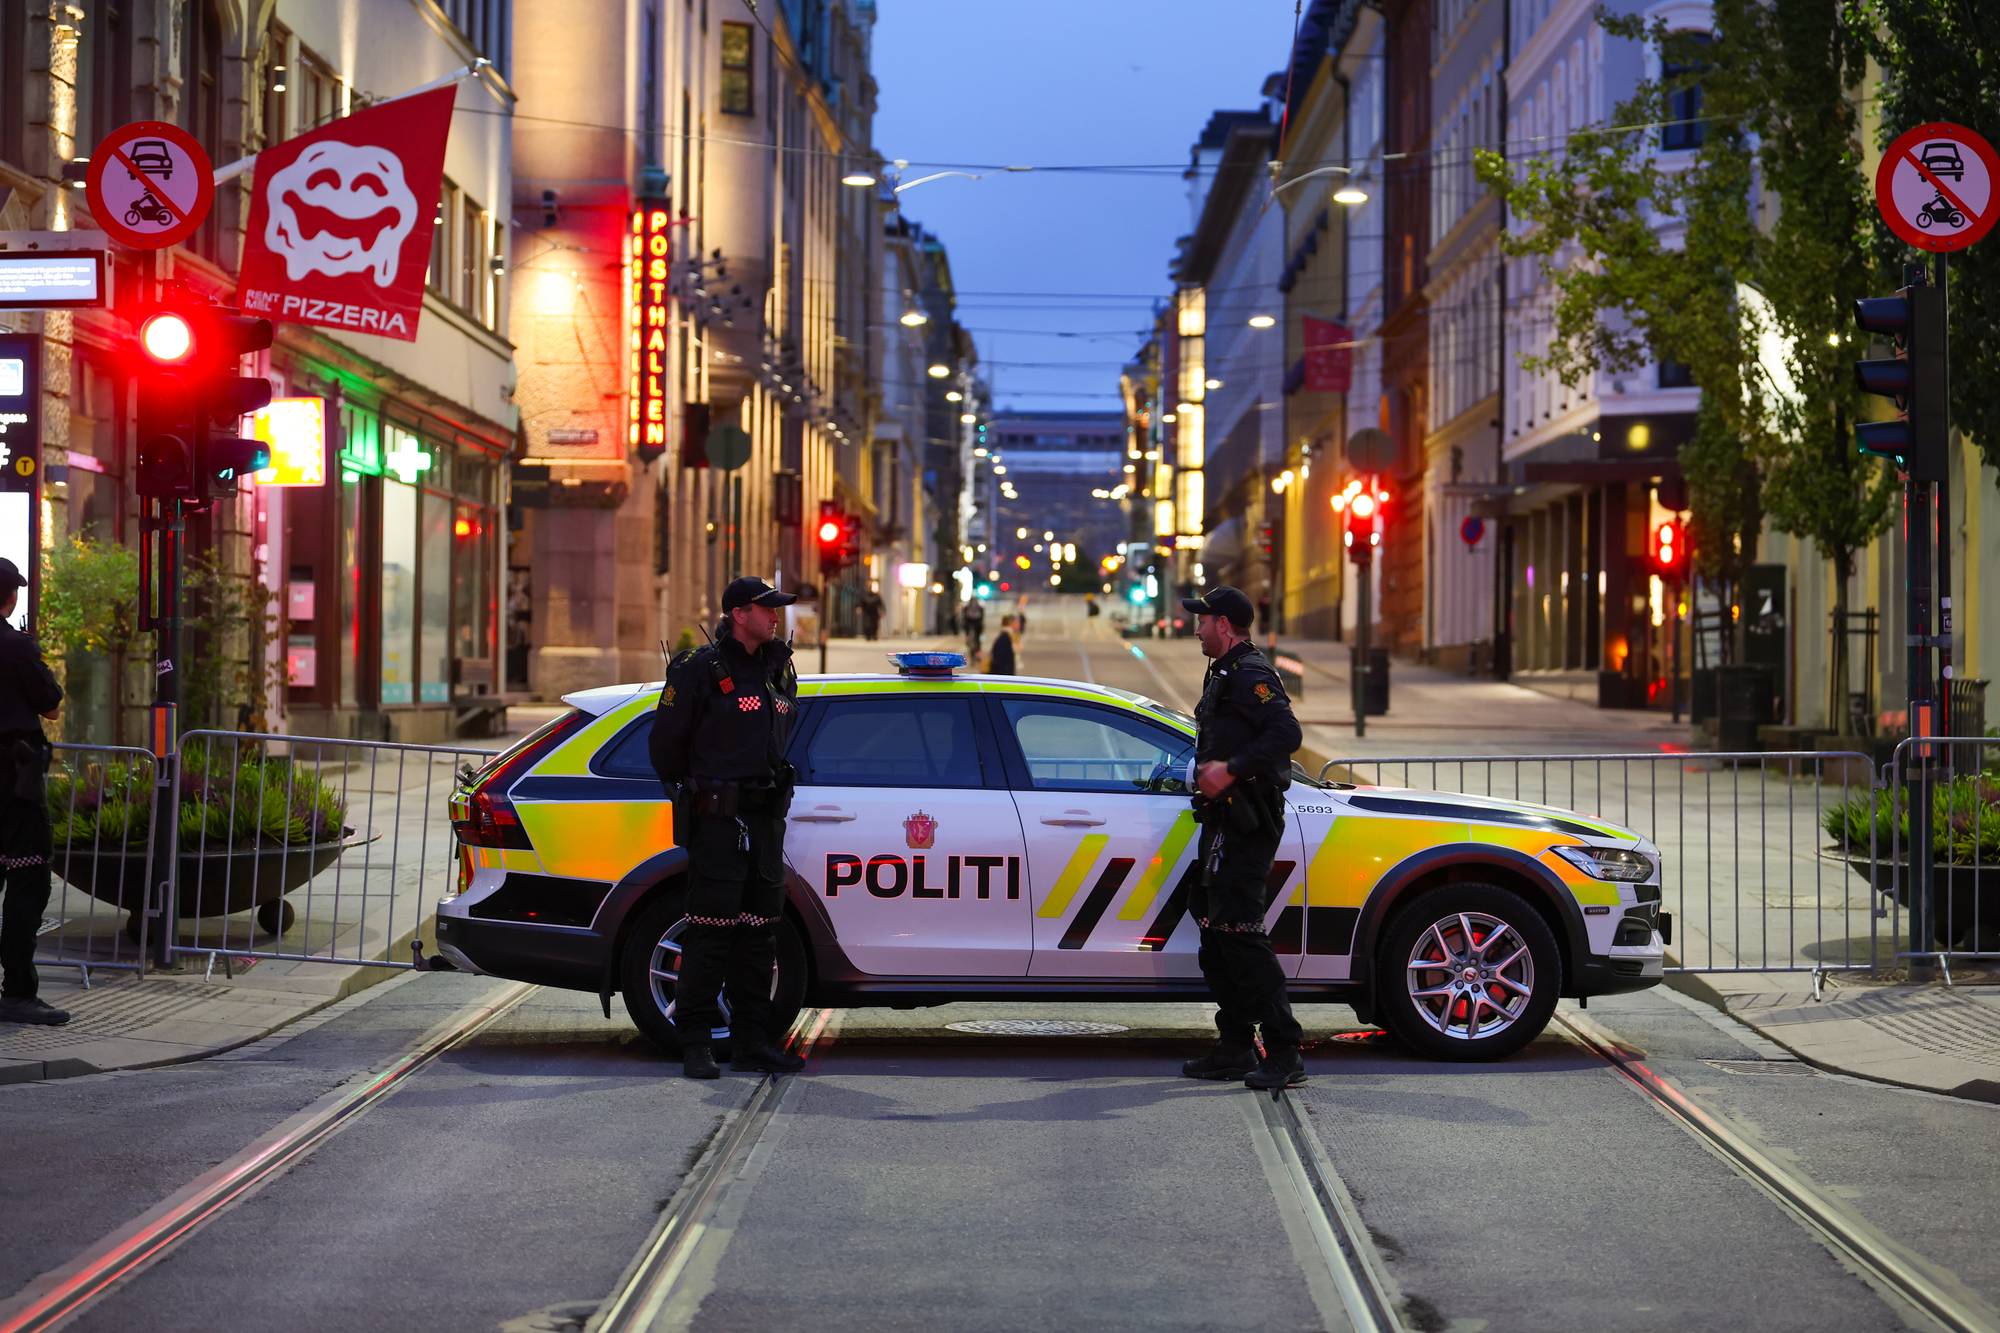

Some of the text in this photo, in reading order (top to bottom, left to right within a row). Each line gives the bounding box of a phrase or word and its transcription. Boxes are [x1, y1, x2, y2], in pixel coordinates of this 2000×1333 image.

[245, 288, 281, 304] RENT
[282, 295, 407, 333] PIZZERIA
[646, 210, 668, 445] POSTHALLEN
[1298, 804, 1333, 814] 5693
[825, 852, 1021, 900] POLITI
